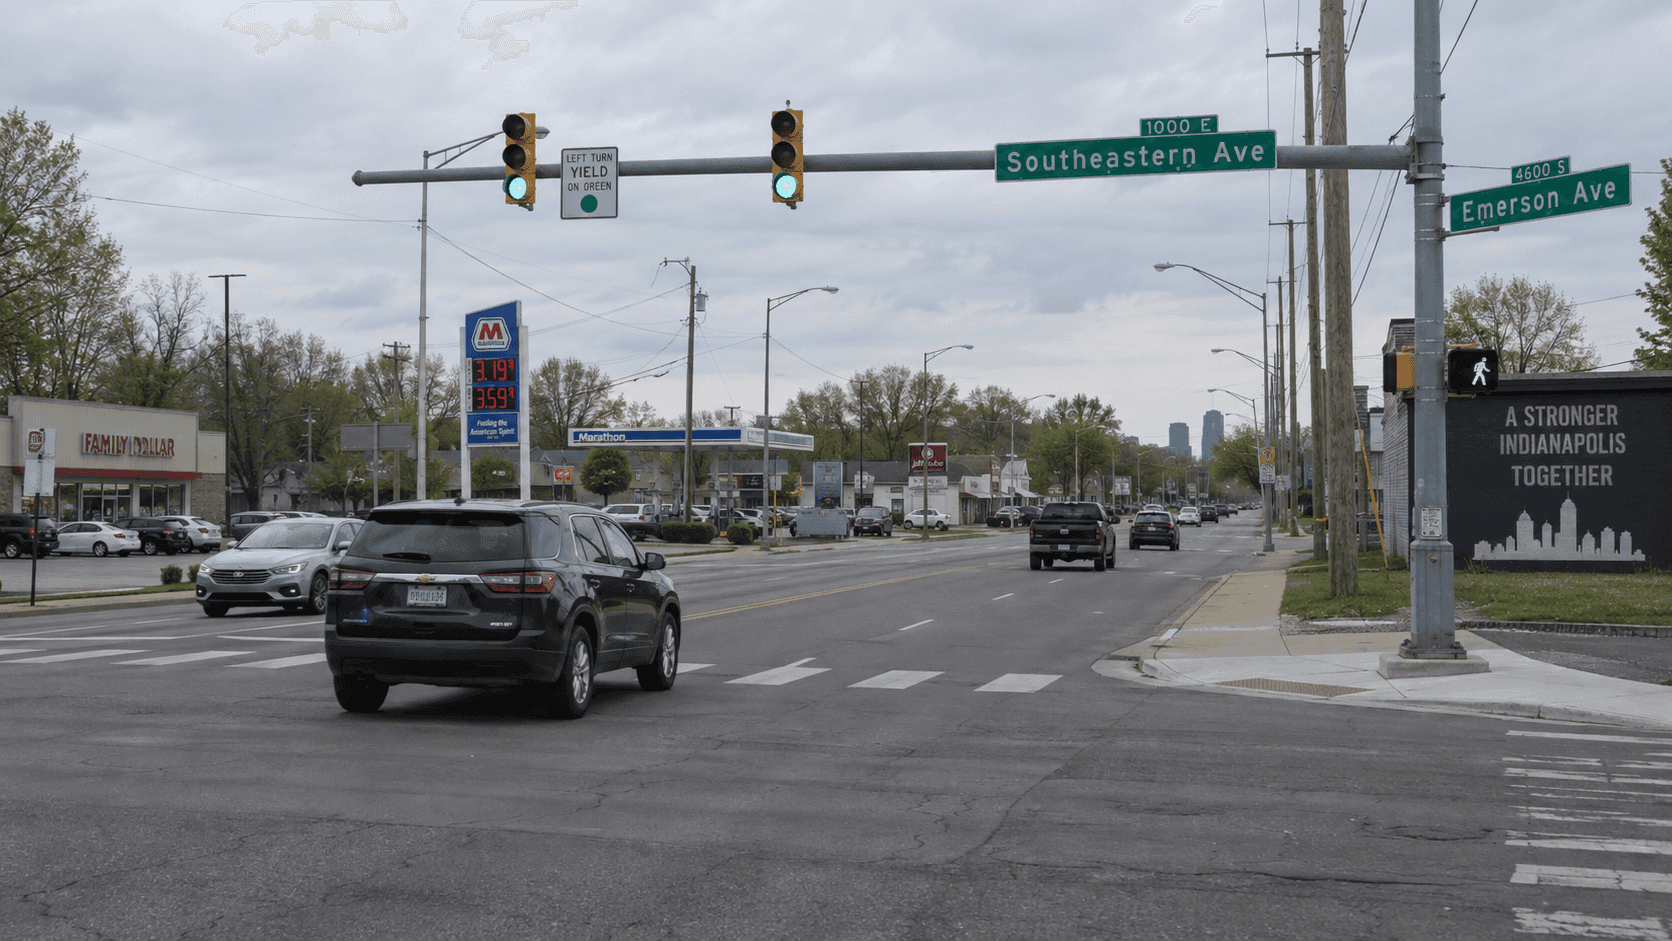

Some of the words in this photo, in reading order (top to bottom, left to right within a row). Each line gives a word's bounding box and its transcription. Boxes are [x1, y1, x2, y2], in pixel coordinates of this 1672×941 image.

[1145, 119, 1190, 135] 1000
[1200, 118, 1211, 132] E
[567, 154, 586, 163] LEFT
[591, 153, 612, 162] TURN
[1006, 145, 1196, 173] Southeastern
[1213, 141, 1265, 163] Ave
[571, 165, 608, 178] YIELD
[1515, 162, 1550, 182] 4600
[1557, 159, 1565, 174] S
[567, 182, 579, 191] ON
[583, 181, 612, 191] GREEN
[1462, 190, 1559, 223] Emerson
[1573, 180, 1616, 205] Ave
[1505, 406, 1517, 427] A
[1524, 404, 1618, 427] STRONGER
[84, 433, 129, 455] FAMILY
[578, 432, 626, 442] Marathon
[1500, 432, 1626, 455] INDIANAPOLIS
[1511, 465, 1613, 486] TOGETHER
